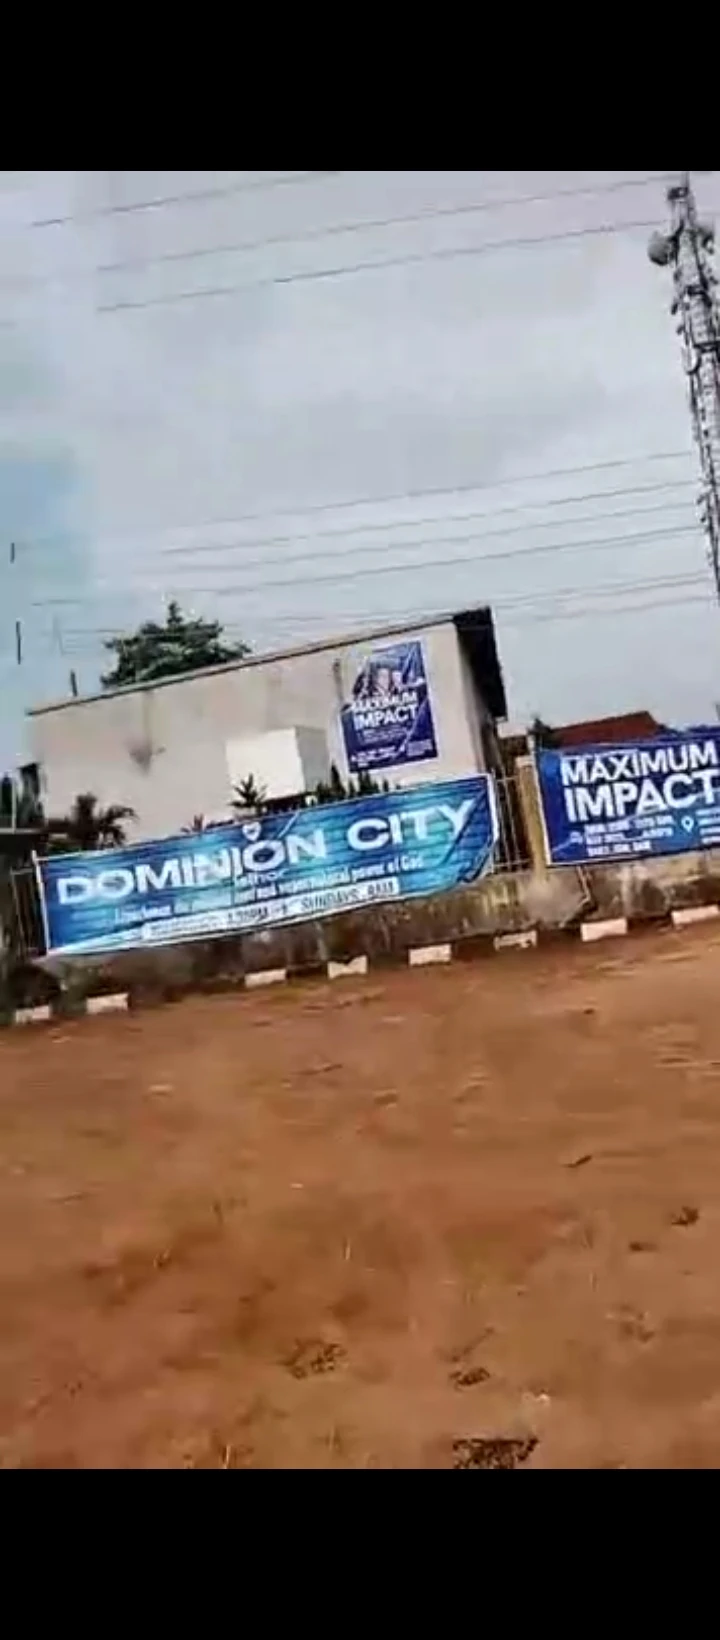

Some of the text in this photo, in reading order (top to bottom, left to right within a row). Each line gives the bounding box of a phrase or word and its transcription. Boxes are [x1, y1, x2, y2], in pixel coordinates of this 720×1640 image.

[353, 704, 418, 731] IMPACT
[560, 740, 718, 787] MAXIMUM
[564, 769, 720, 823] IMPACT
[56, 827, 327, 905] DOMINION
[347, 798, 476, 851] CITY
